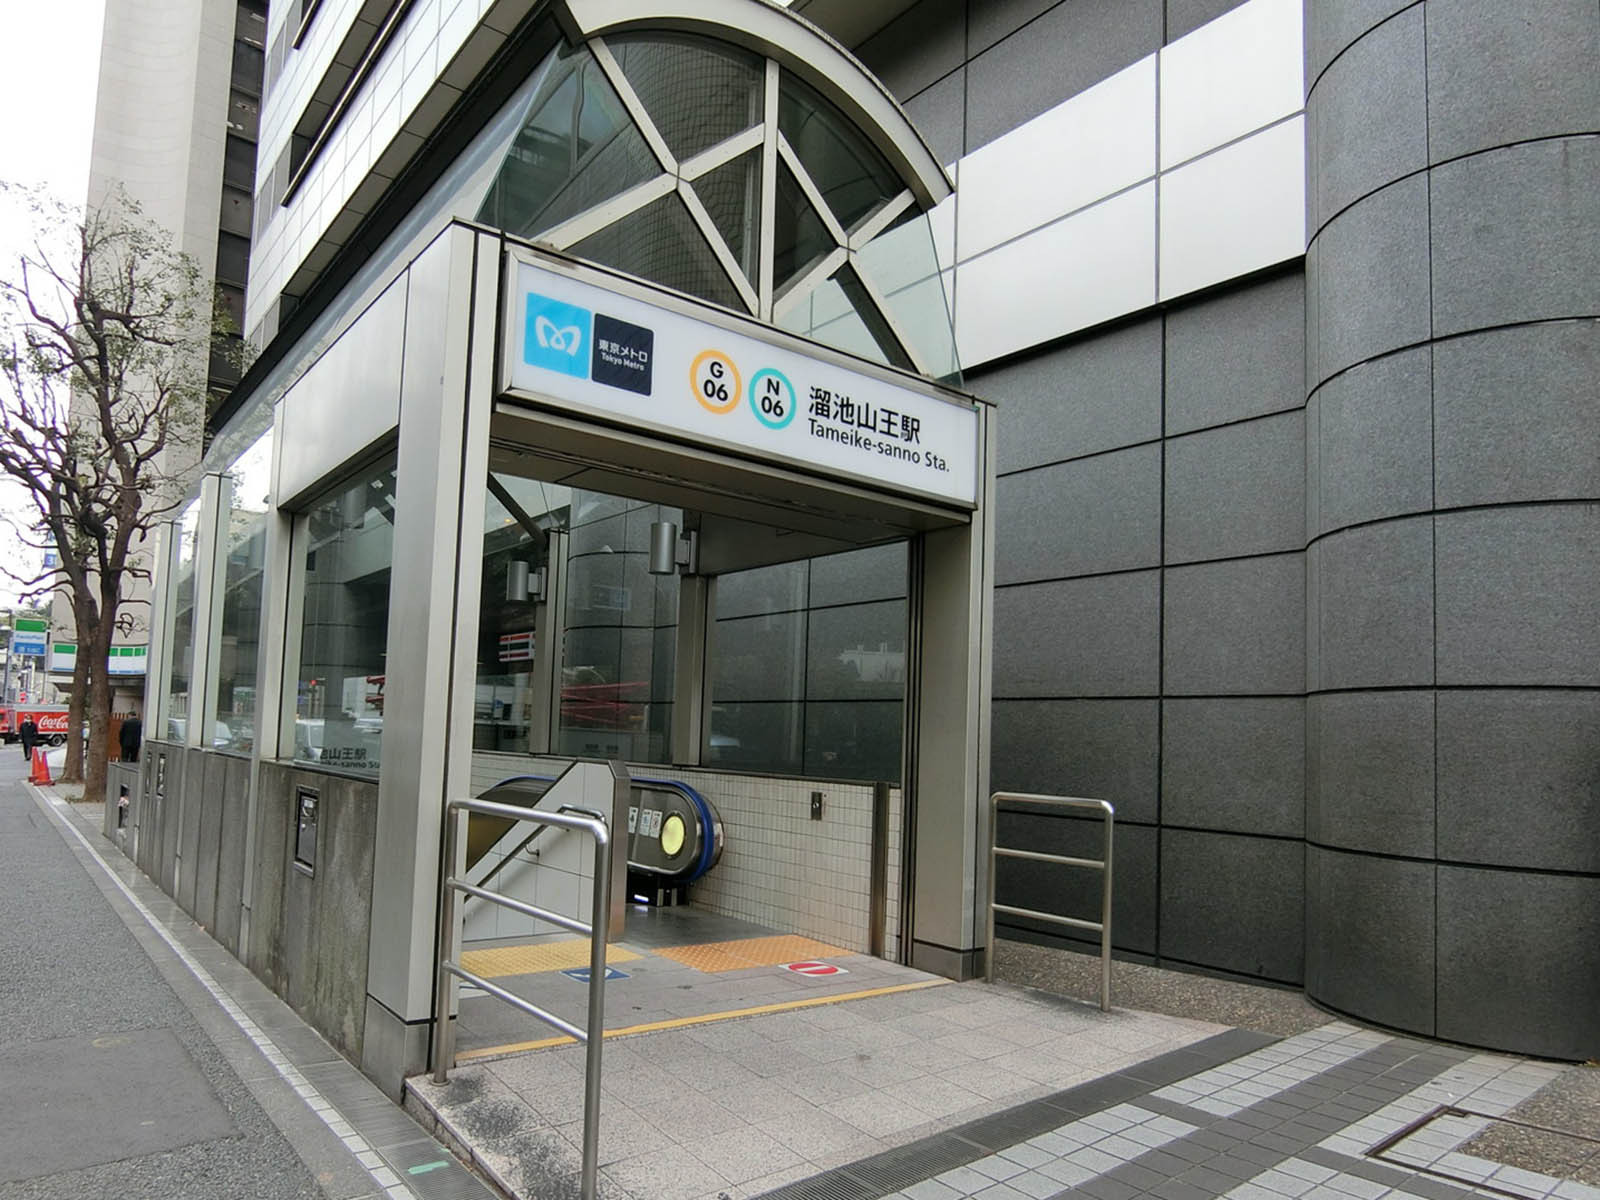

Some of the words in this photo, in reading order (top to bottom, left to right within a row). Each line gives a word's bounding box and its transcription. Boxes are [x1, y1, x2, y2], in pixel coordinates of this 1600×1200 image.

[599, 339, 648, 363] 東京メトロ
[601, 351, 623, 365] Tokyo
[623, 358, 645, 371] Metro
[709, 361, 724, 379] G
[703, 379, 729, 402] 06
[767, 378, 780, 396] N
[761, 396, 784, 417] 06
[808, 386, 920, 444] 溜池山王駅
[808, 418, 920, 464] Tameike-sanno
[925, 452, 950, 472] Sta.
